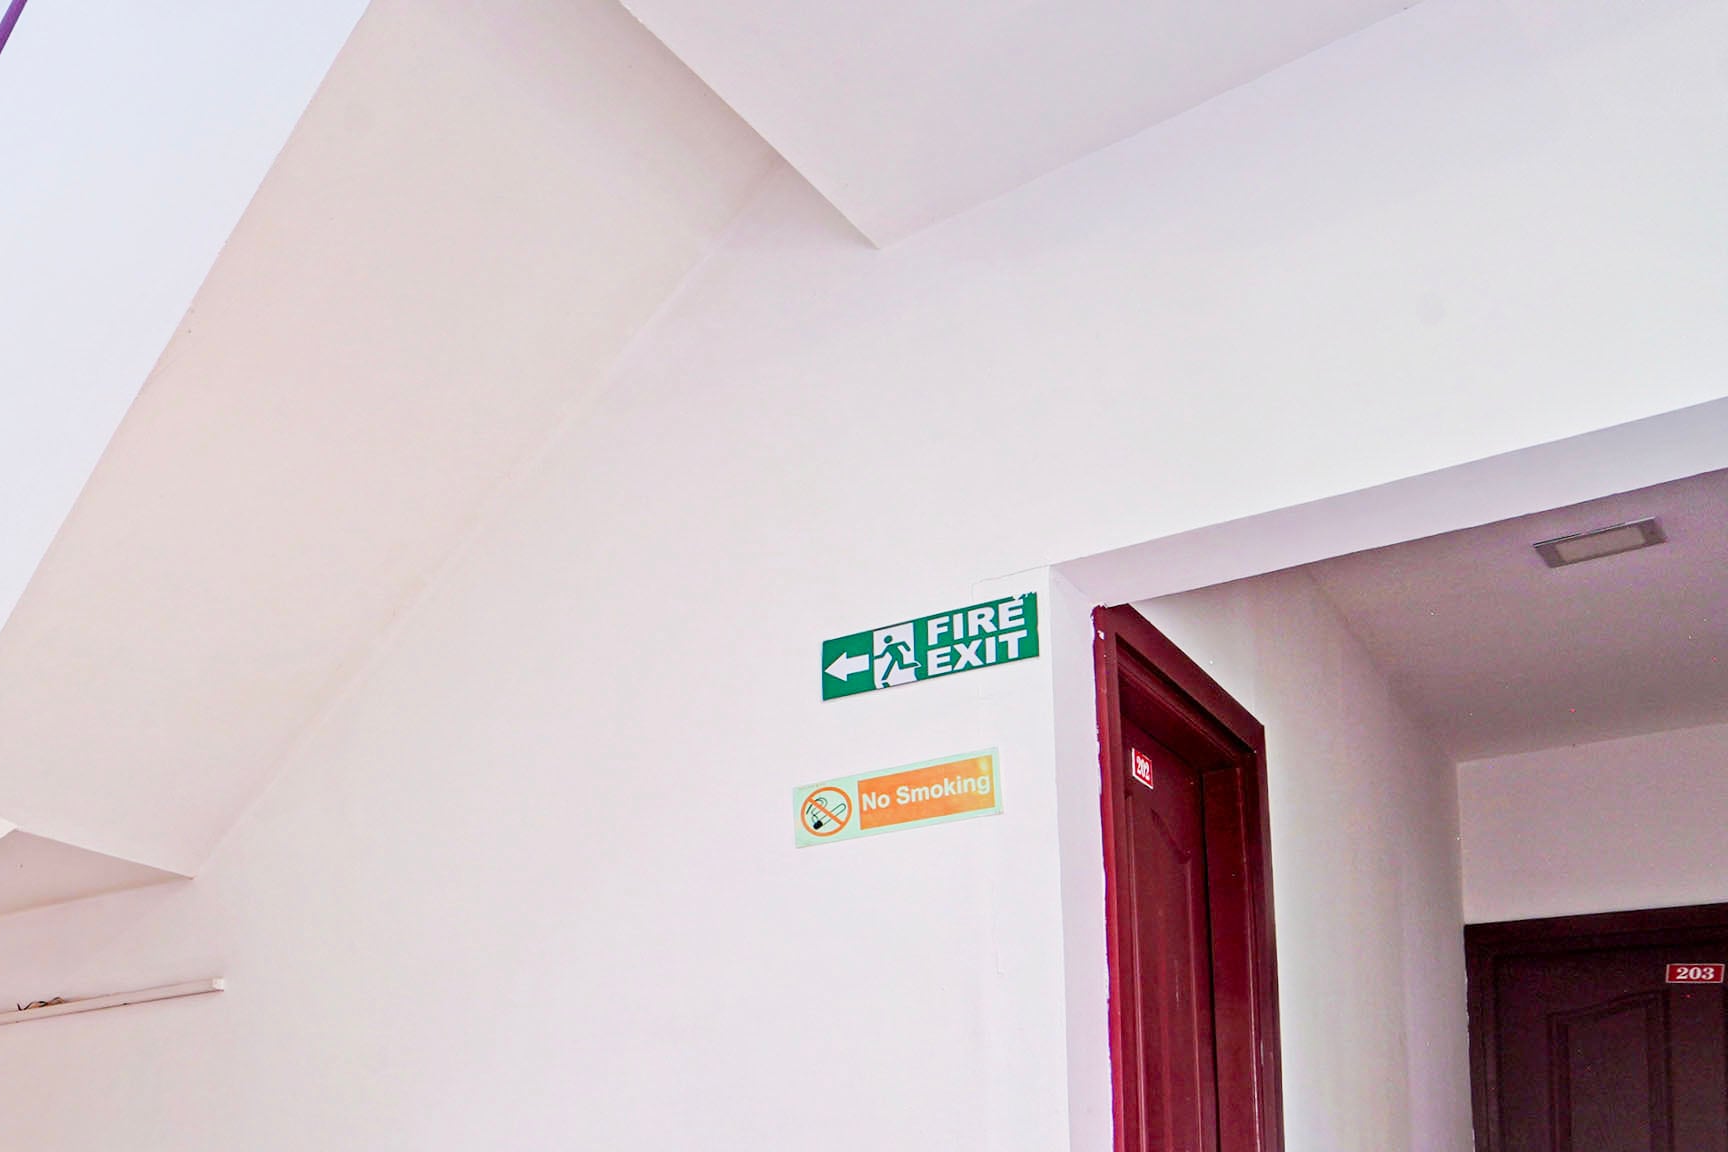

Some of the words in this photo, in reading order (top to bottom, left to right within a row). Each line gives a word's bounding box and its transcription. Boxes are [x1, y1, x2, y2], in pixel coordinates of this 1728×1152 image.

[927, 599, 1025, 646] FIRE
[927, 629, 1028, 676] EXIT
[862, 791, 891, 811] No
[895, 775, 991, 805] Smoking
[1675, 966, 1715, 980] 203
